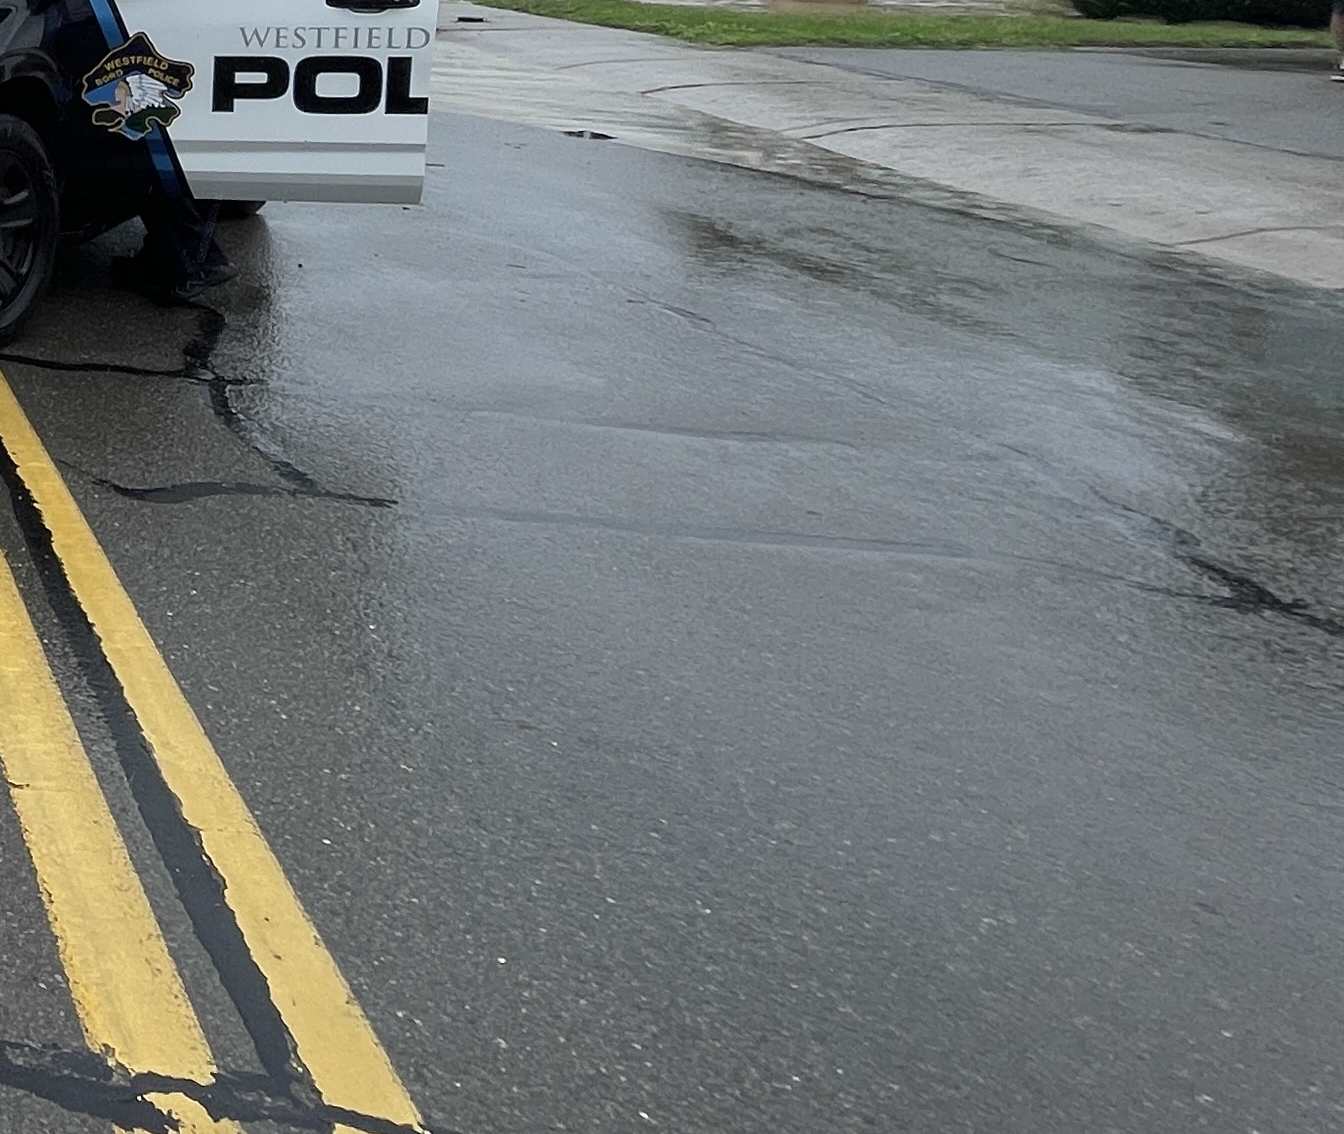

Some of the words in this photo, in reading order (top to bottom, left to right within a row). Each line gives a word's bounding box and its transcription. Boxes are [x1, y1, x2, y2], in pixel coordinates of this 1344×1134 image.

[239, 26, 431, 49] WESTFIELD
[104, 55, 169, 72] WESTFIELD
[148, 68, 180, 87] POLICE
[212, 55, 429, 114] POL
